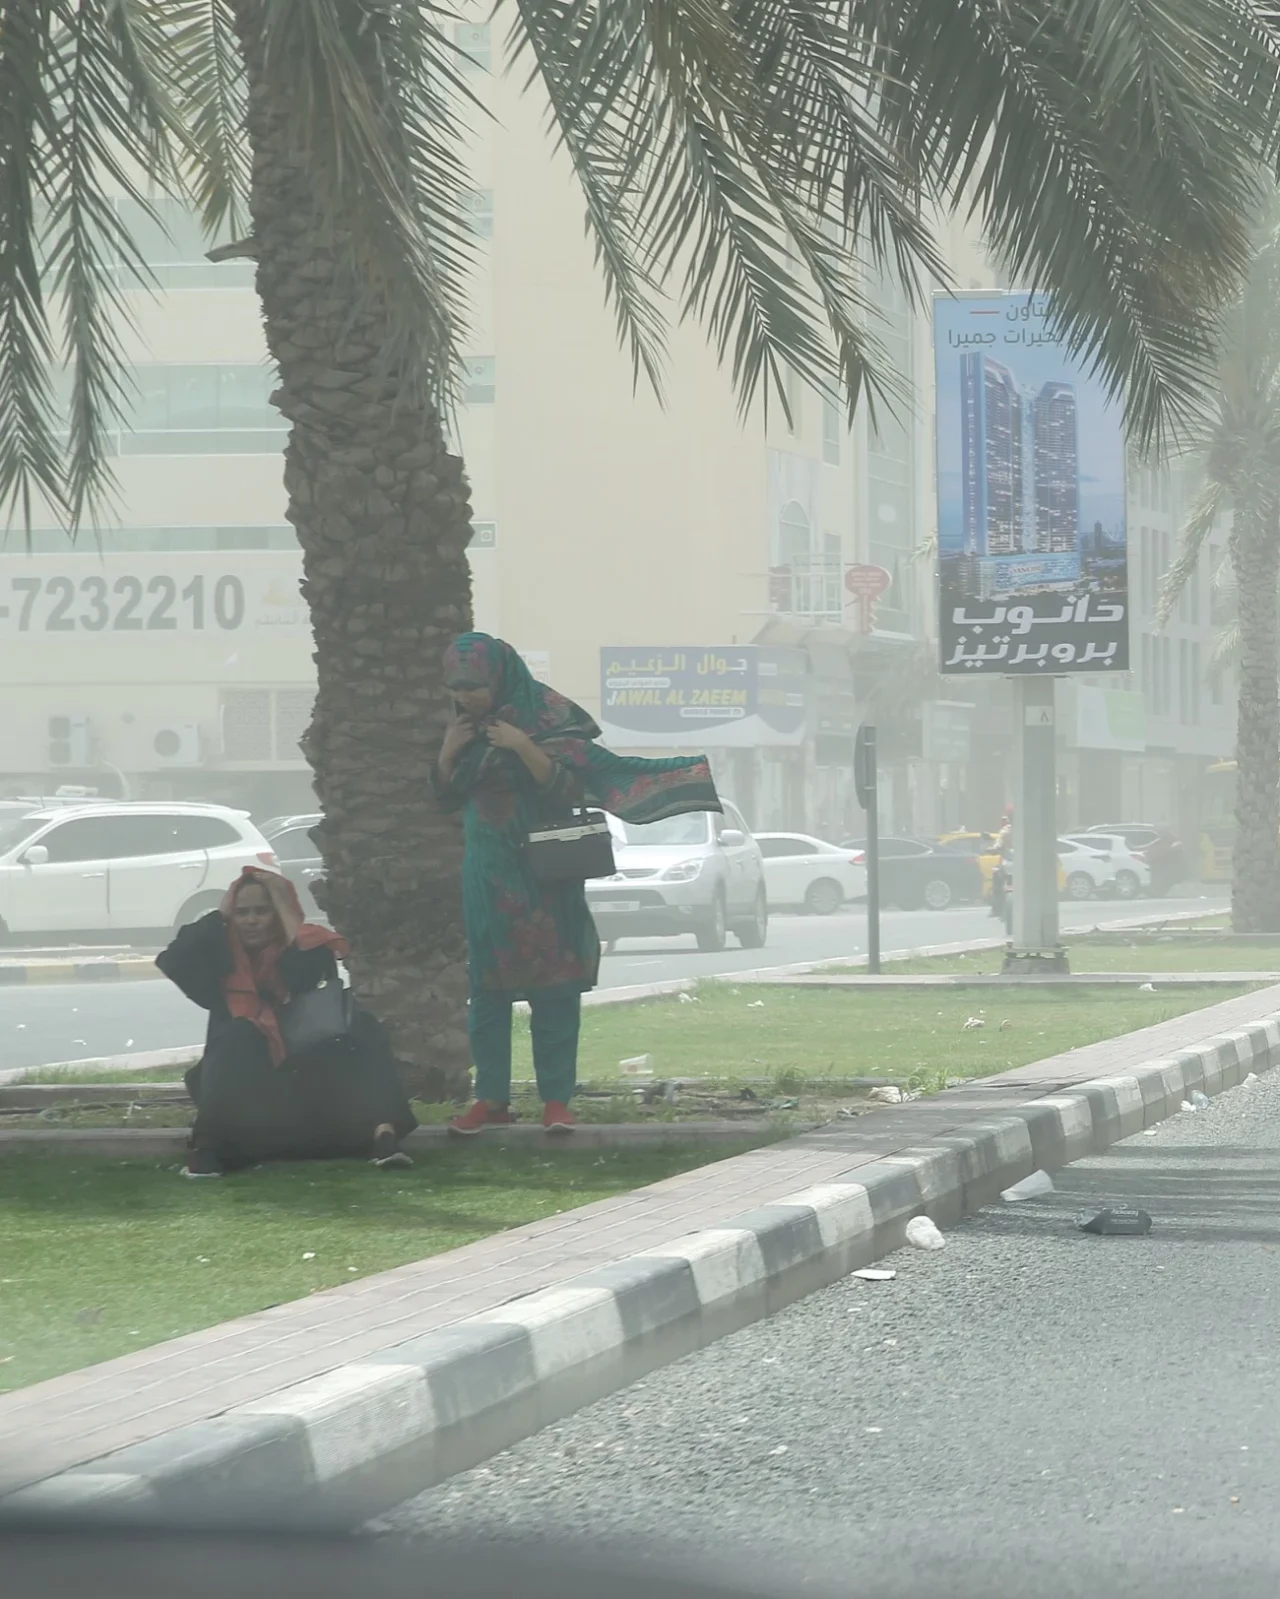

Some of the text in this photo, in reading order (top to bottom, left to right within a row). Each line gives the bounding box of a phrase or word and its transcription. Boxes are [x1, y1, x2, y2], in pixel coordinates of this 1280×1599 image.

[948, 329, 997, 348] جميرا
[951, 594, 1125, 635] دانوب
[945, 632, 1119, 668] بروبرتيز
[606, 654, 686, 676] الزعيم
[697, 654, 748, 676] جوال
[606, 690, 662, 706] JAWAL
[665, 690, 686, 706] AL
[690, 689, 748, 705] ZAEEM
